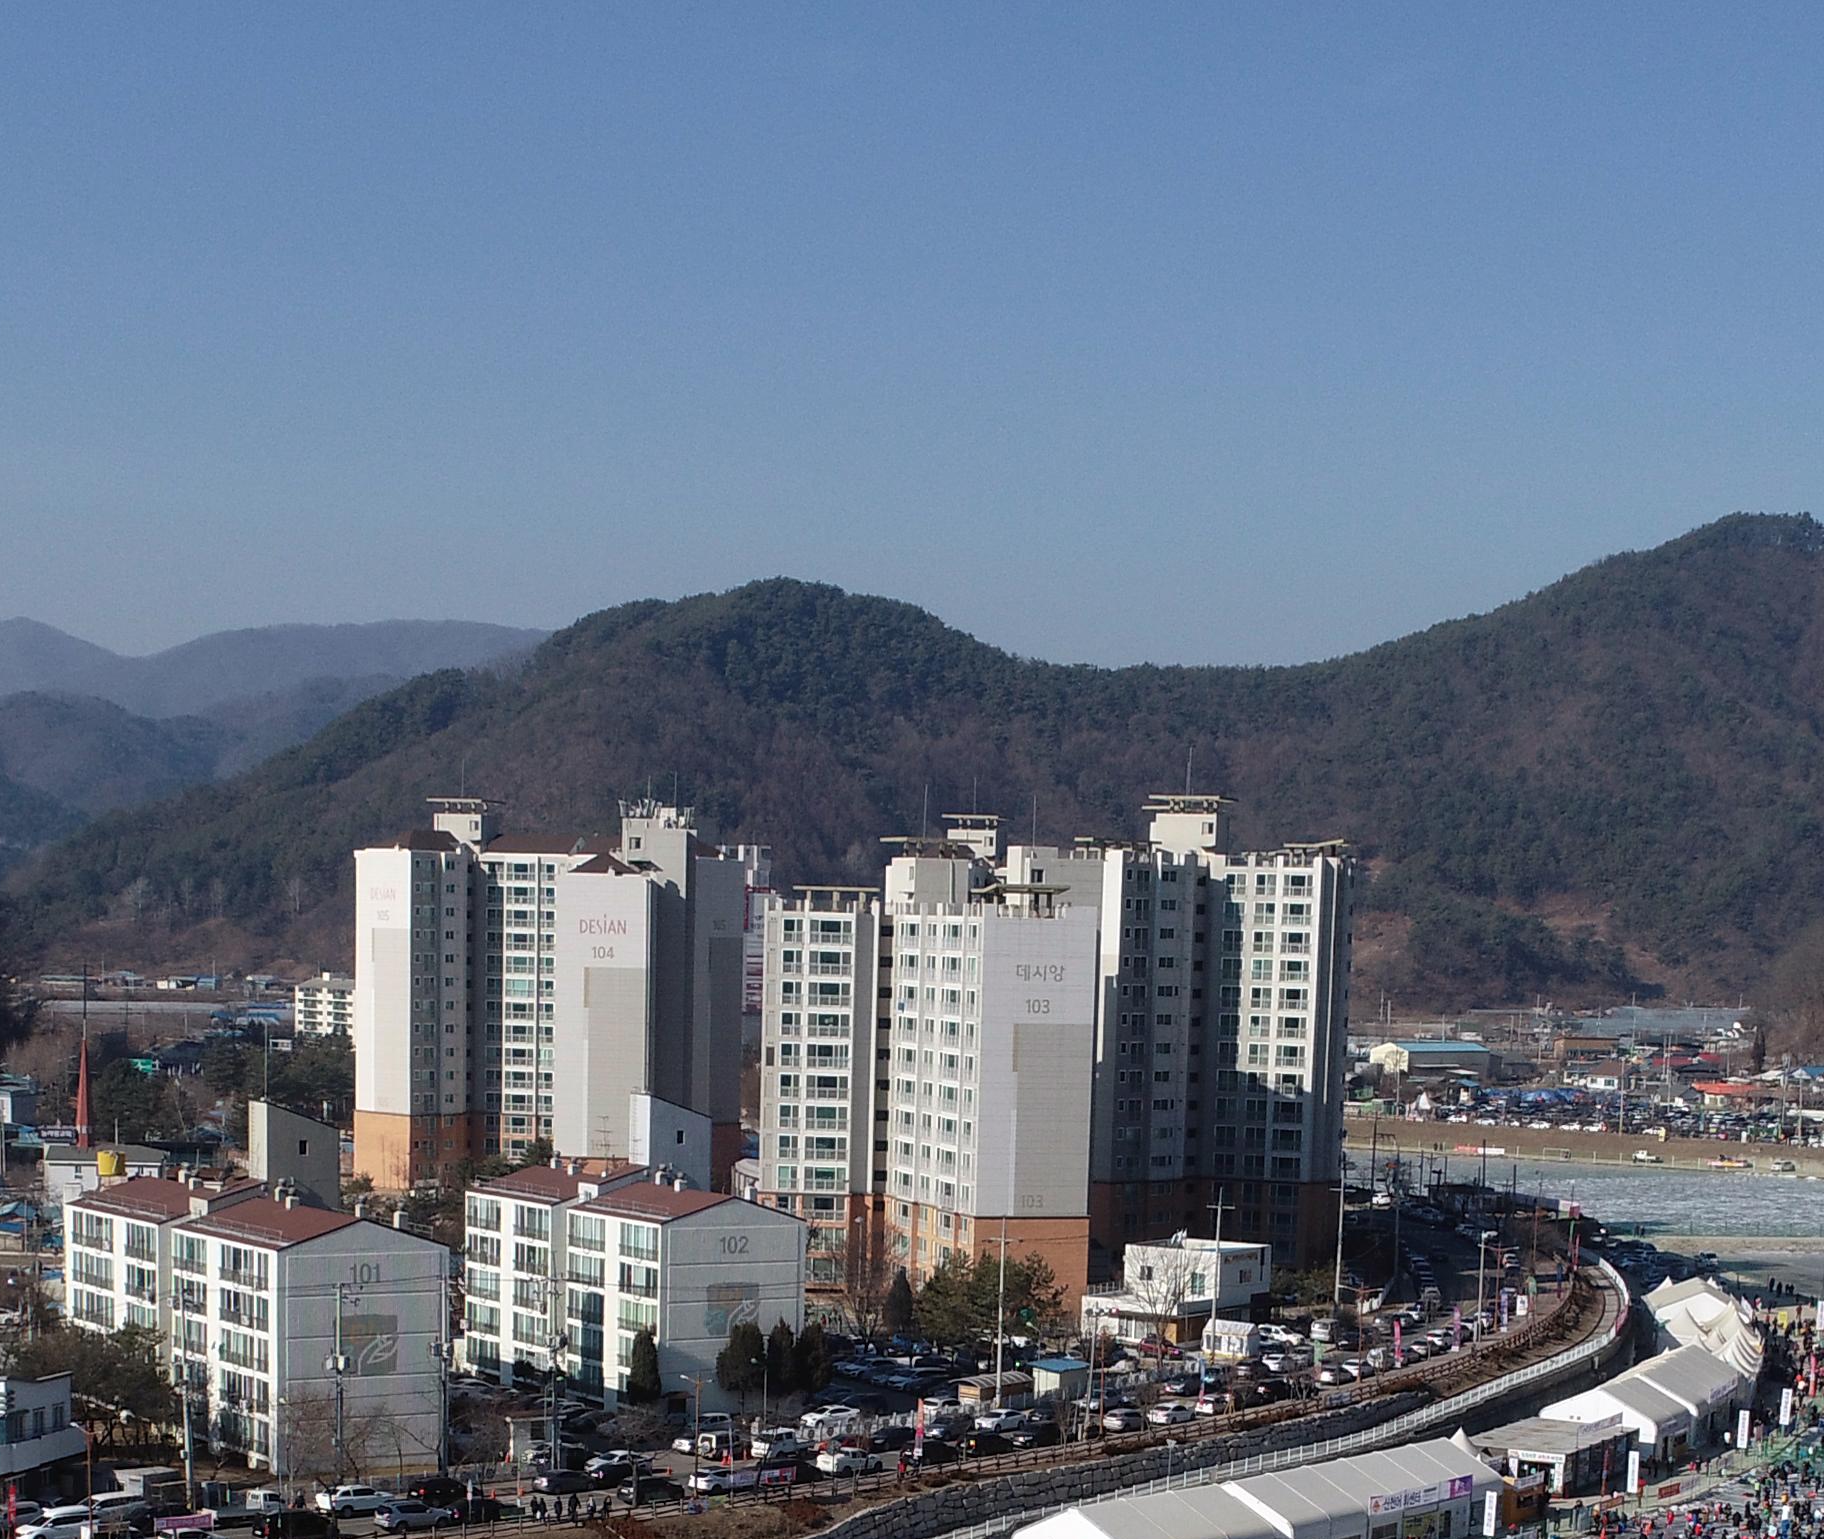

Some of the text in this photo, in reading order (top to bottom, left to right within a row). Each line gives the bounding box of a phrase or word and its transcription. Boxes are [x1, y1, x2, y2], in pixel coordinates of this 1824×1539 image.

[579, 913, 627, 935] DESIAN
[591, 946, 614, 960] 104
[1016, 963, 1065, 983] 데시앙
[1025, 998, 1051, 1015] 103
[719, 1236, 749, 1254] 102
[349, 1263, 381, 1284] 101
